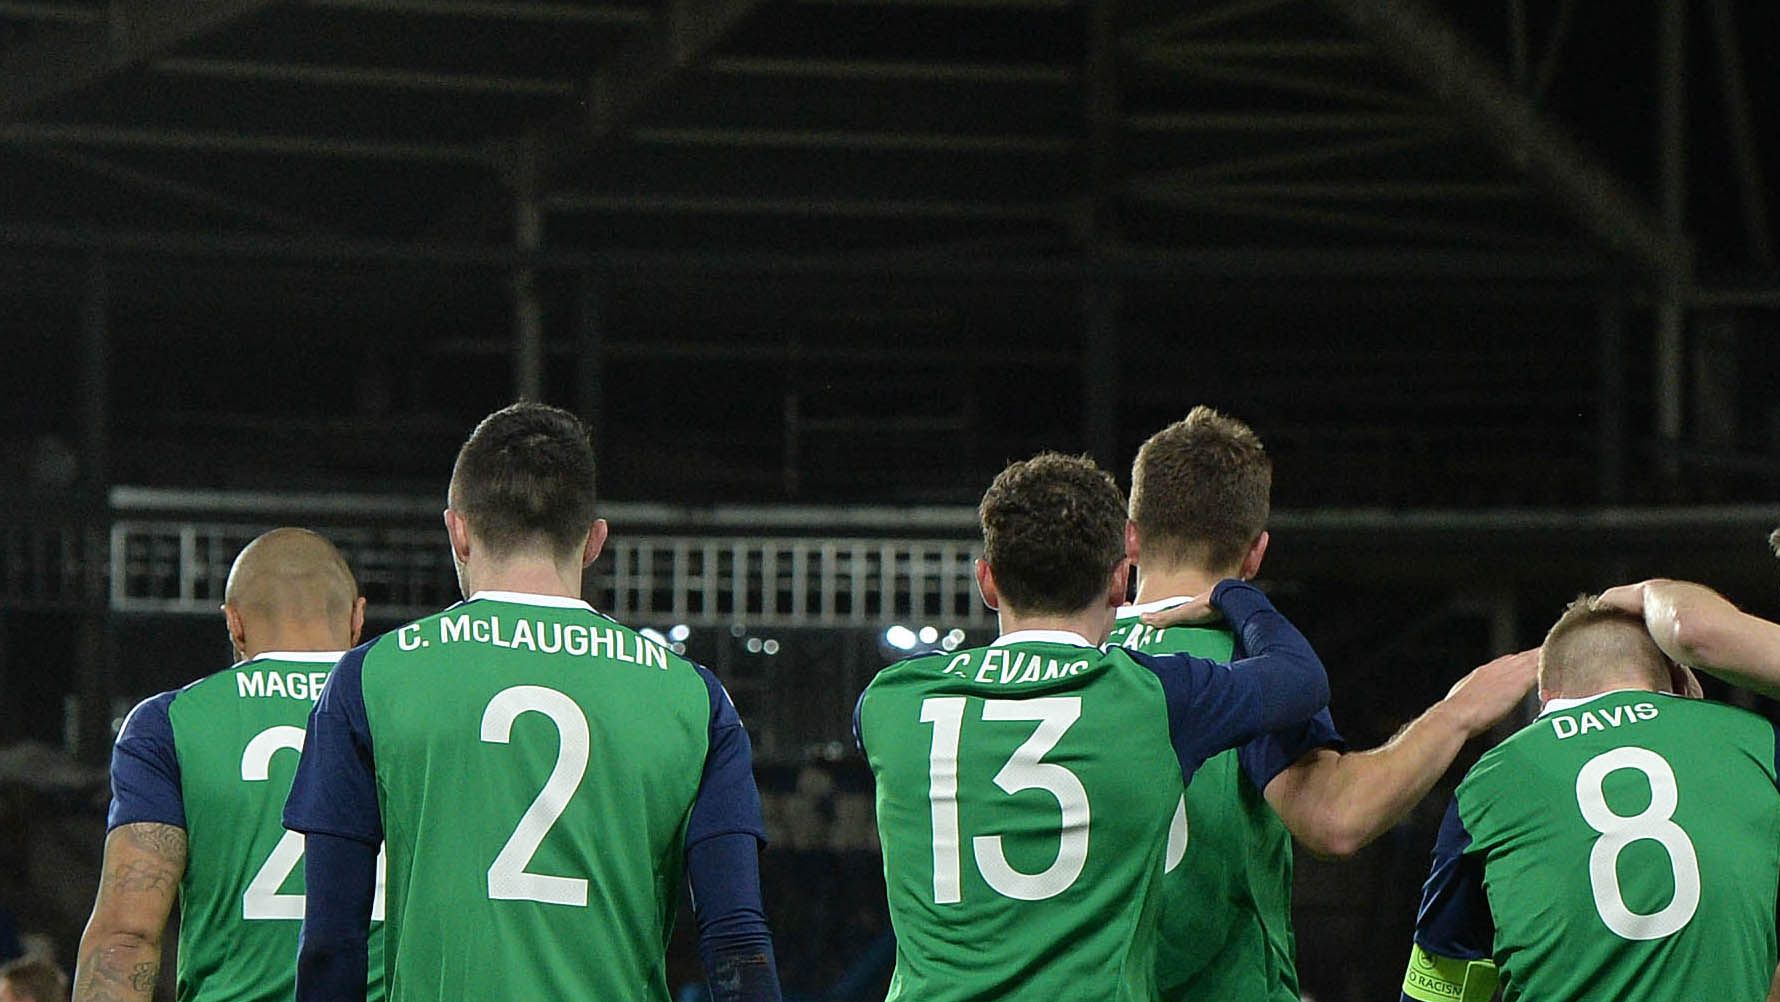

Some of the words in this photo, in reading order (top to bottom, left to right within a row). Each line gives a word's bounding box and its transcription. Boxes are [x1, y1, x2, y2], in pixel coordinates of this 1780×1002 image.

[236, 671, 329, 701] MAGE
[398, 623, 430, 651] C.
[440, 614, 668, 670] McLAUGHLIN
[1551, 702, 1660, 740] DAVIS
[480, 685, 590, 907] 2
[919, 696, 1092, 905] 13
[1575, 746, 1701, 941] 8
